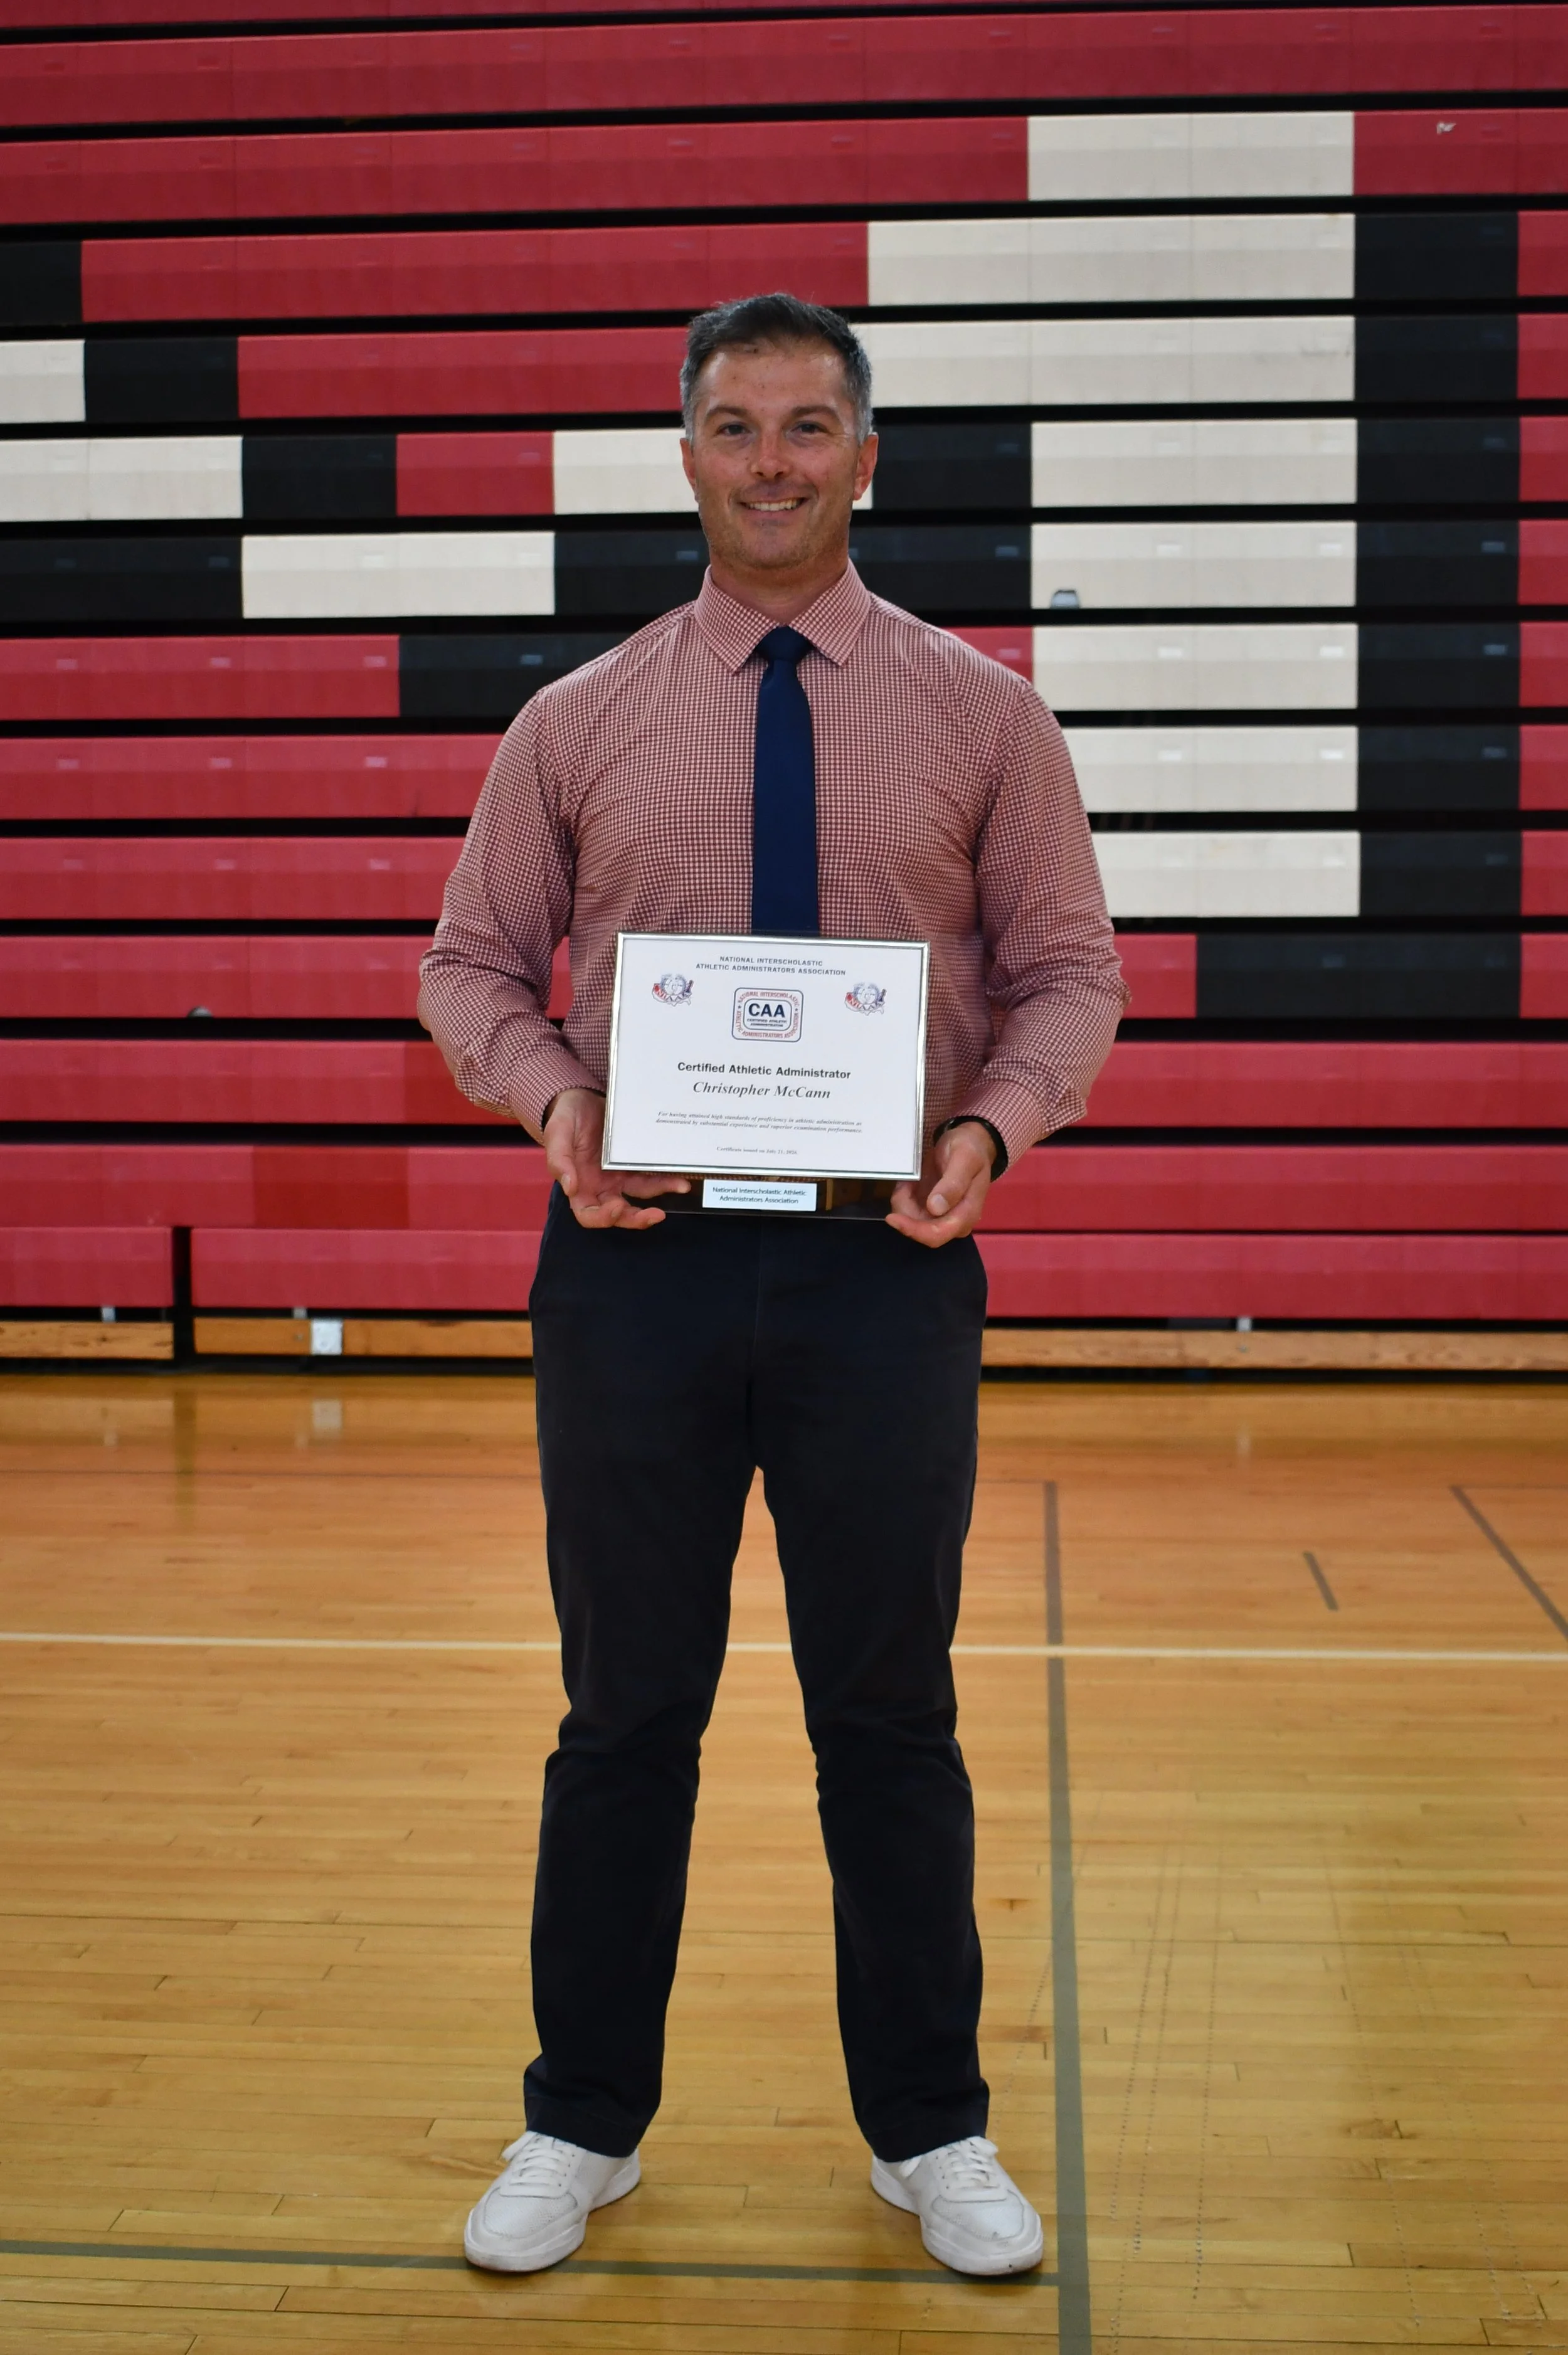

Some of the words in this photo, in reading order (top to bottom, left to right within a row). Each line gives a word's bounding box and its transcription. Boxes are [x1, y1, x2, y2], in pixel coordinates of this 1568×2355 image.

[757, 958, 823, 966] INTERSCHOLASTIC
[732, 965, 796, 974] ADMINISTRATORS
[798, 968, 846, 976] ASSOCIATION
[748, 1003, 785, 1018] CAA
[677, 1062, 725, 1073] Certified
[729, 1065, 772, 1076] Athletic
[776, 1067, 851, 1079] Administrator
[692, 1081, 770, 1098] Christopher
[773, 1086, 831, 1099] McCann
